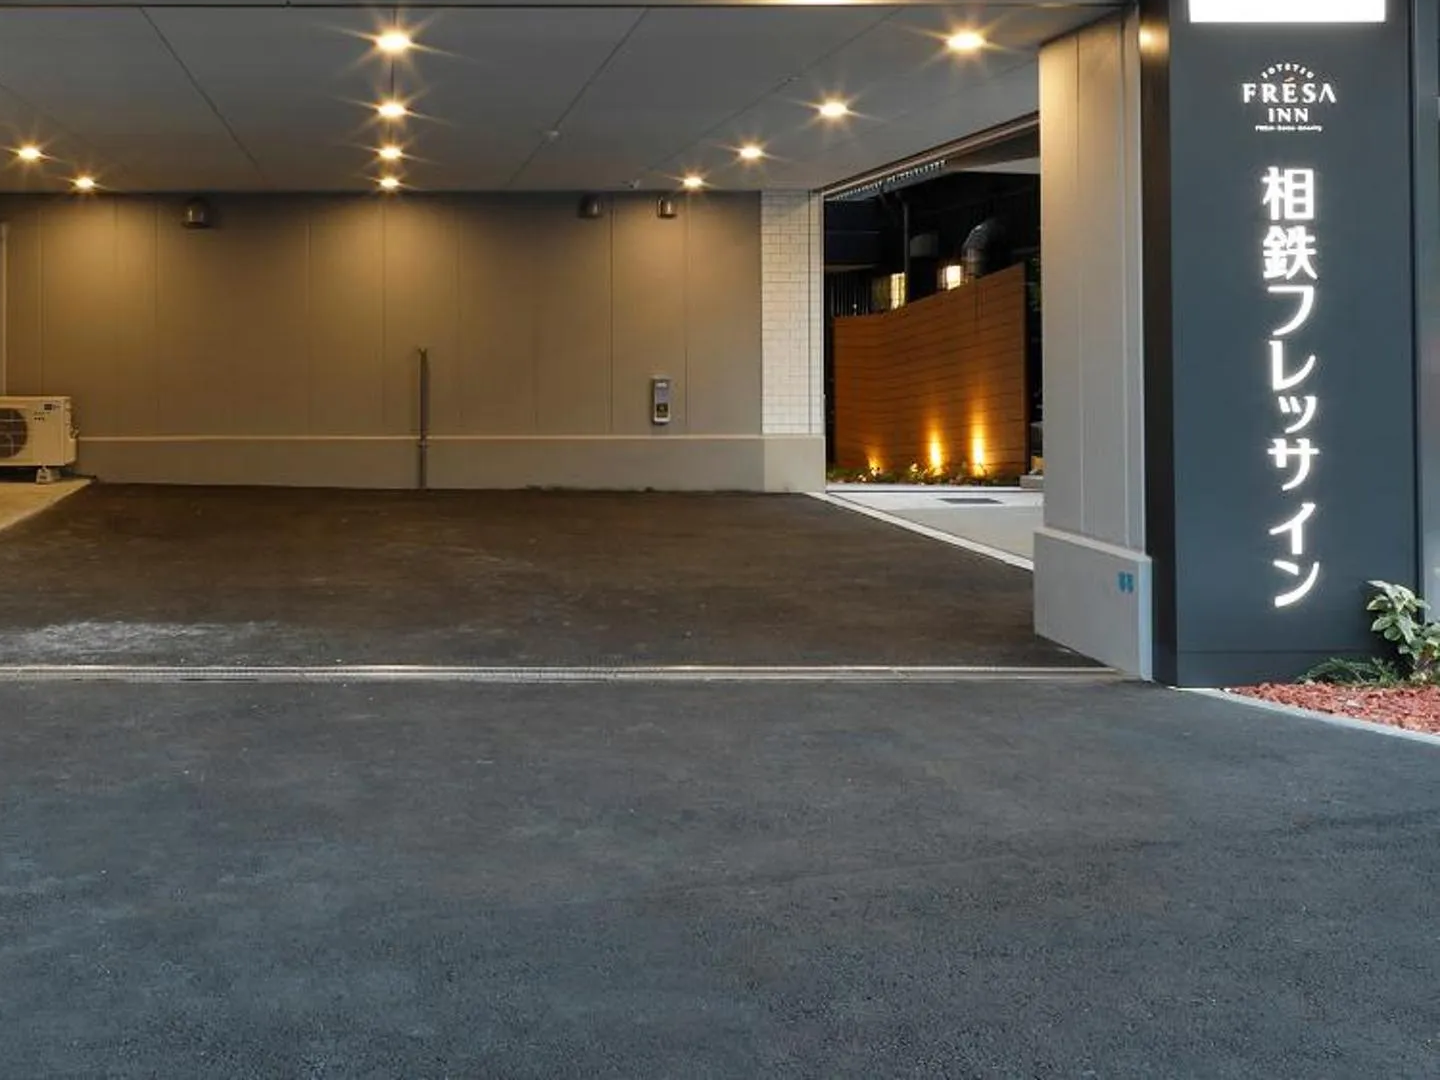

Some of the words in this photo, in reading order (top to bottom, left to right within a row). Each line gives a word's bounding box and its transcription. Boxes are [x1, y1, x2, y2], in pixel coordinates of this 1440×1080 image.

[1268, 107, 1309, 123] INN
[1262, 166, 1320, 608] 相鉄フレッサイン
